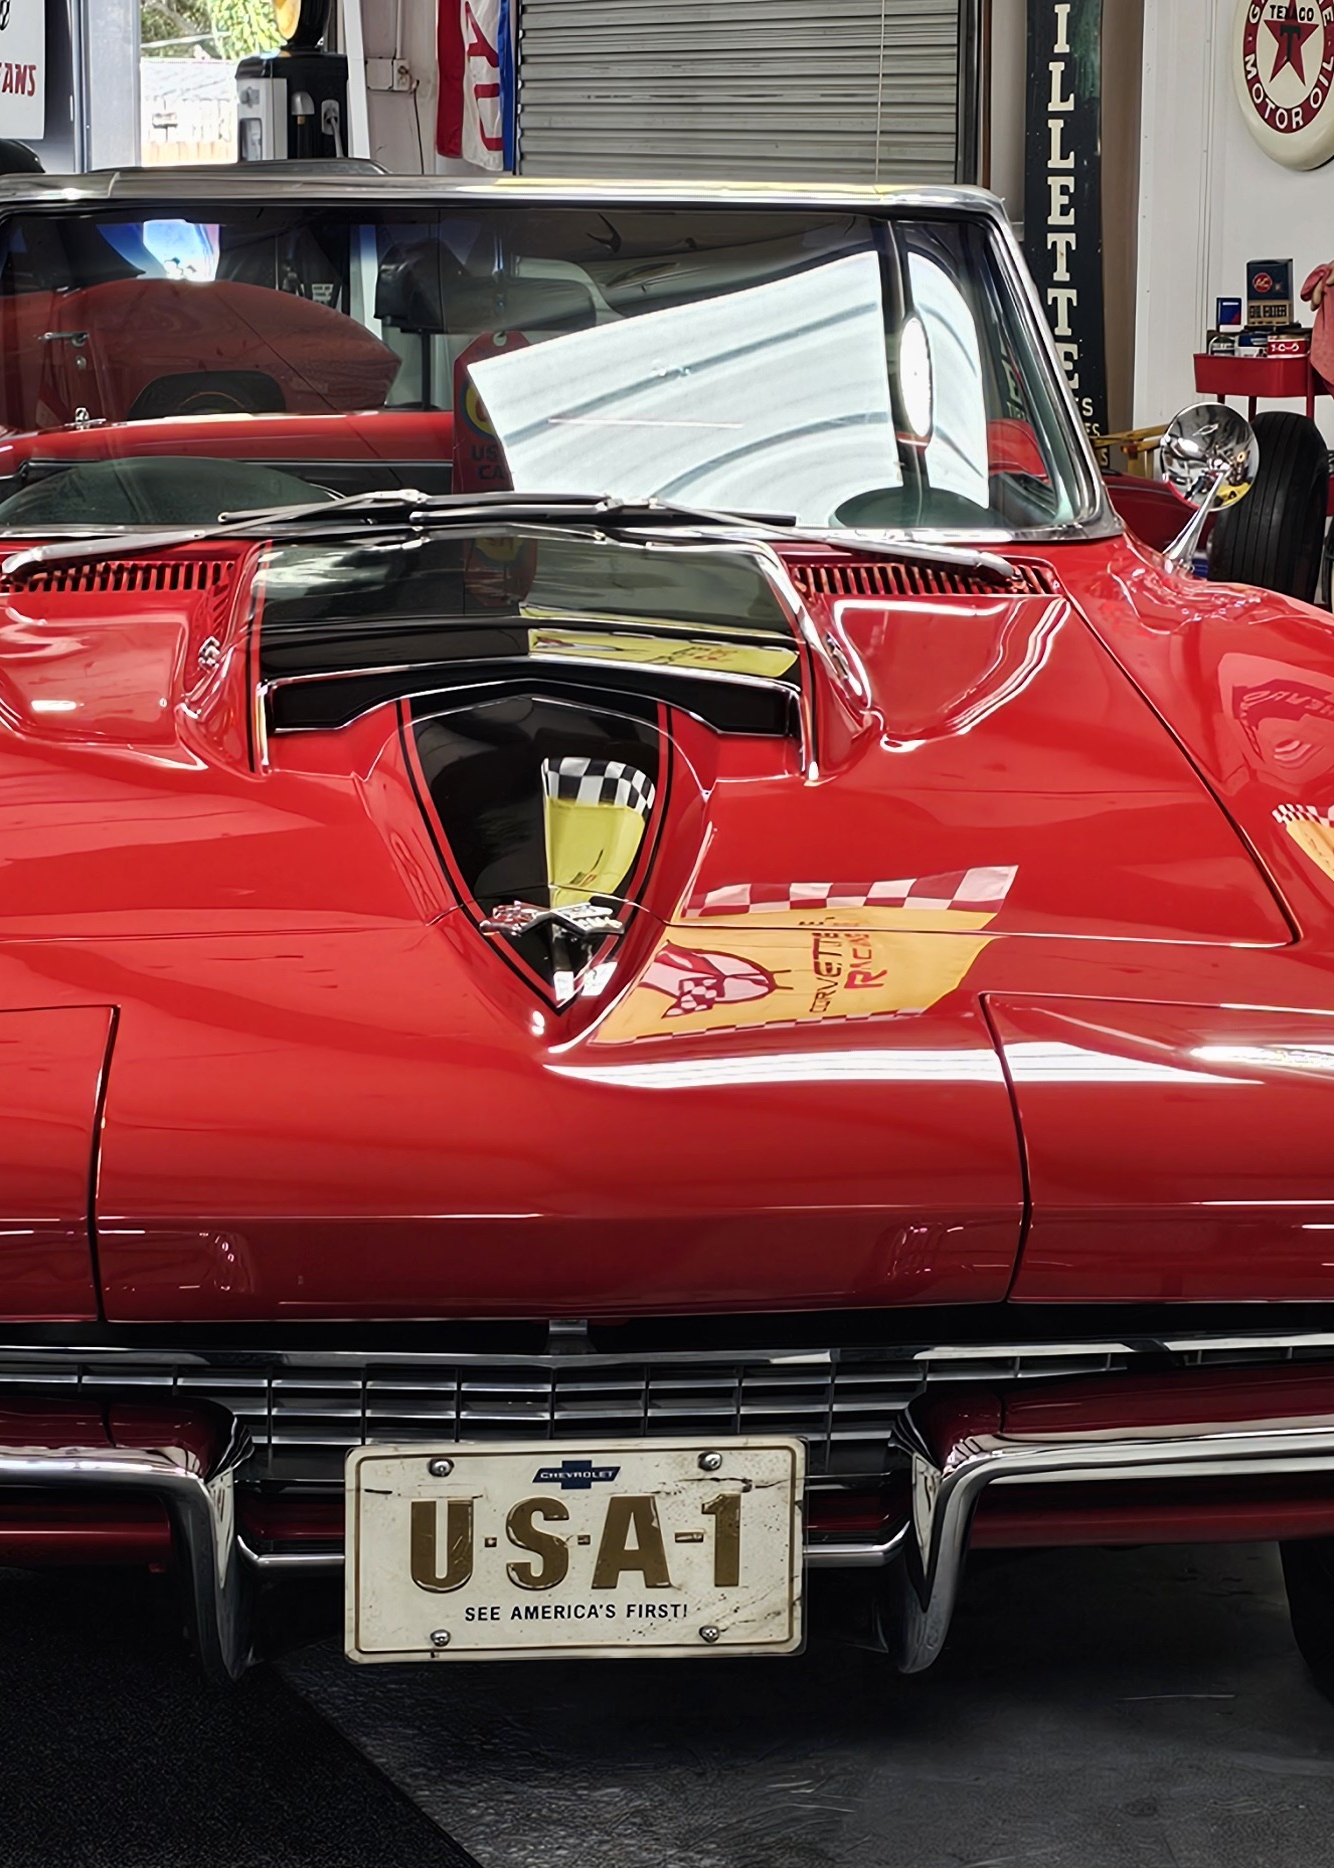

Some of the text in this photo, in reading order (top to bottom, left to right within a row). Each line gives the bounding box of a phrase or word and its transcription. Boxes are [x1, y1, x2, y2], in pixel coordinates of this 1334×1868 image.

[1269, 4, 1315, 22] TECO
[1244, 53, 1305, 130] MOTOR
[540, 1470, 614, 1480] CHEVROLET
[464, 1603, 688, 1622] SEE AMERICA'S FIRST!
